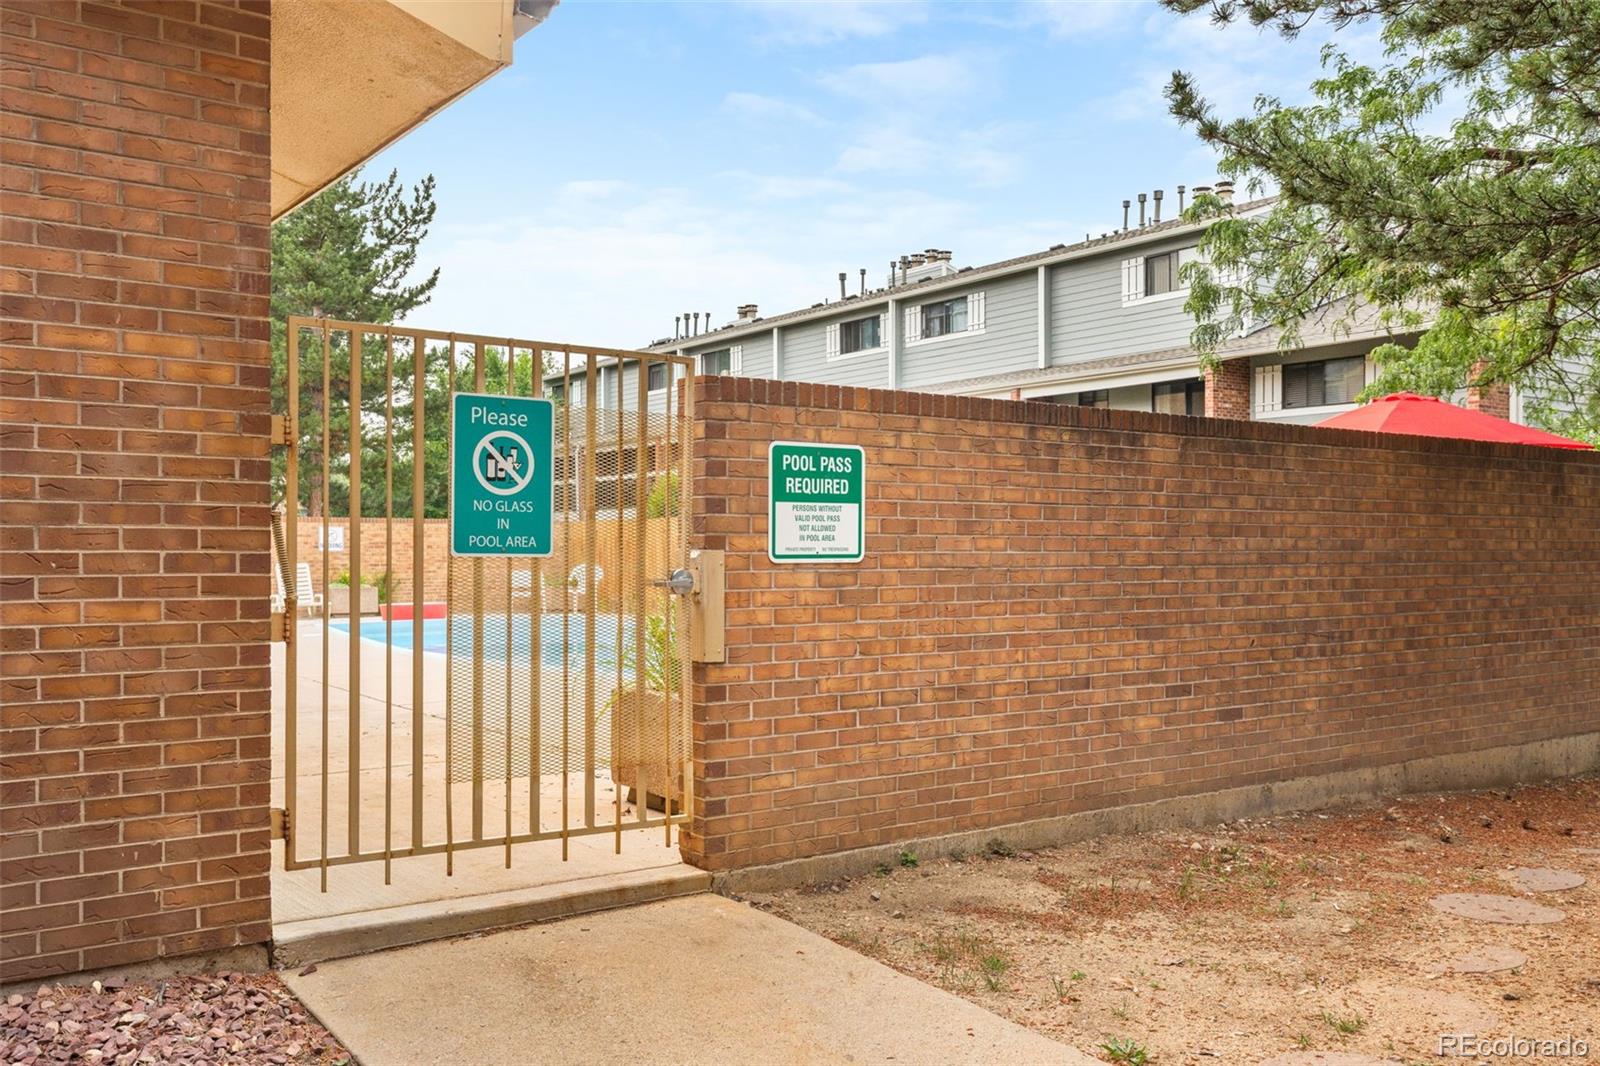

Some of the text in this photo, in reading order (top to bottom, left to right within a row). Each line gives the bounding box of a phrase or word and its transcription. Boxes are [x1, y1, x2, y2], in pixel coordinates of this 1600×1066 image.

[471, 407, 528, 427] Please
[783, 455, 852, 473] POOL PASS
[786, 478, 849, 495] REQUIRED
[473, 500, 534, 513] NO GLASS
[792, 504, 817, 512] PERSONS
[497, 518, 510, 530] IN
[469, 535, 537, 548] POOL AREA
